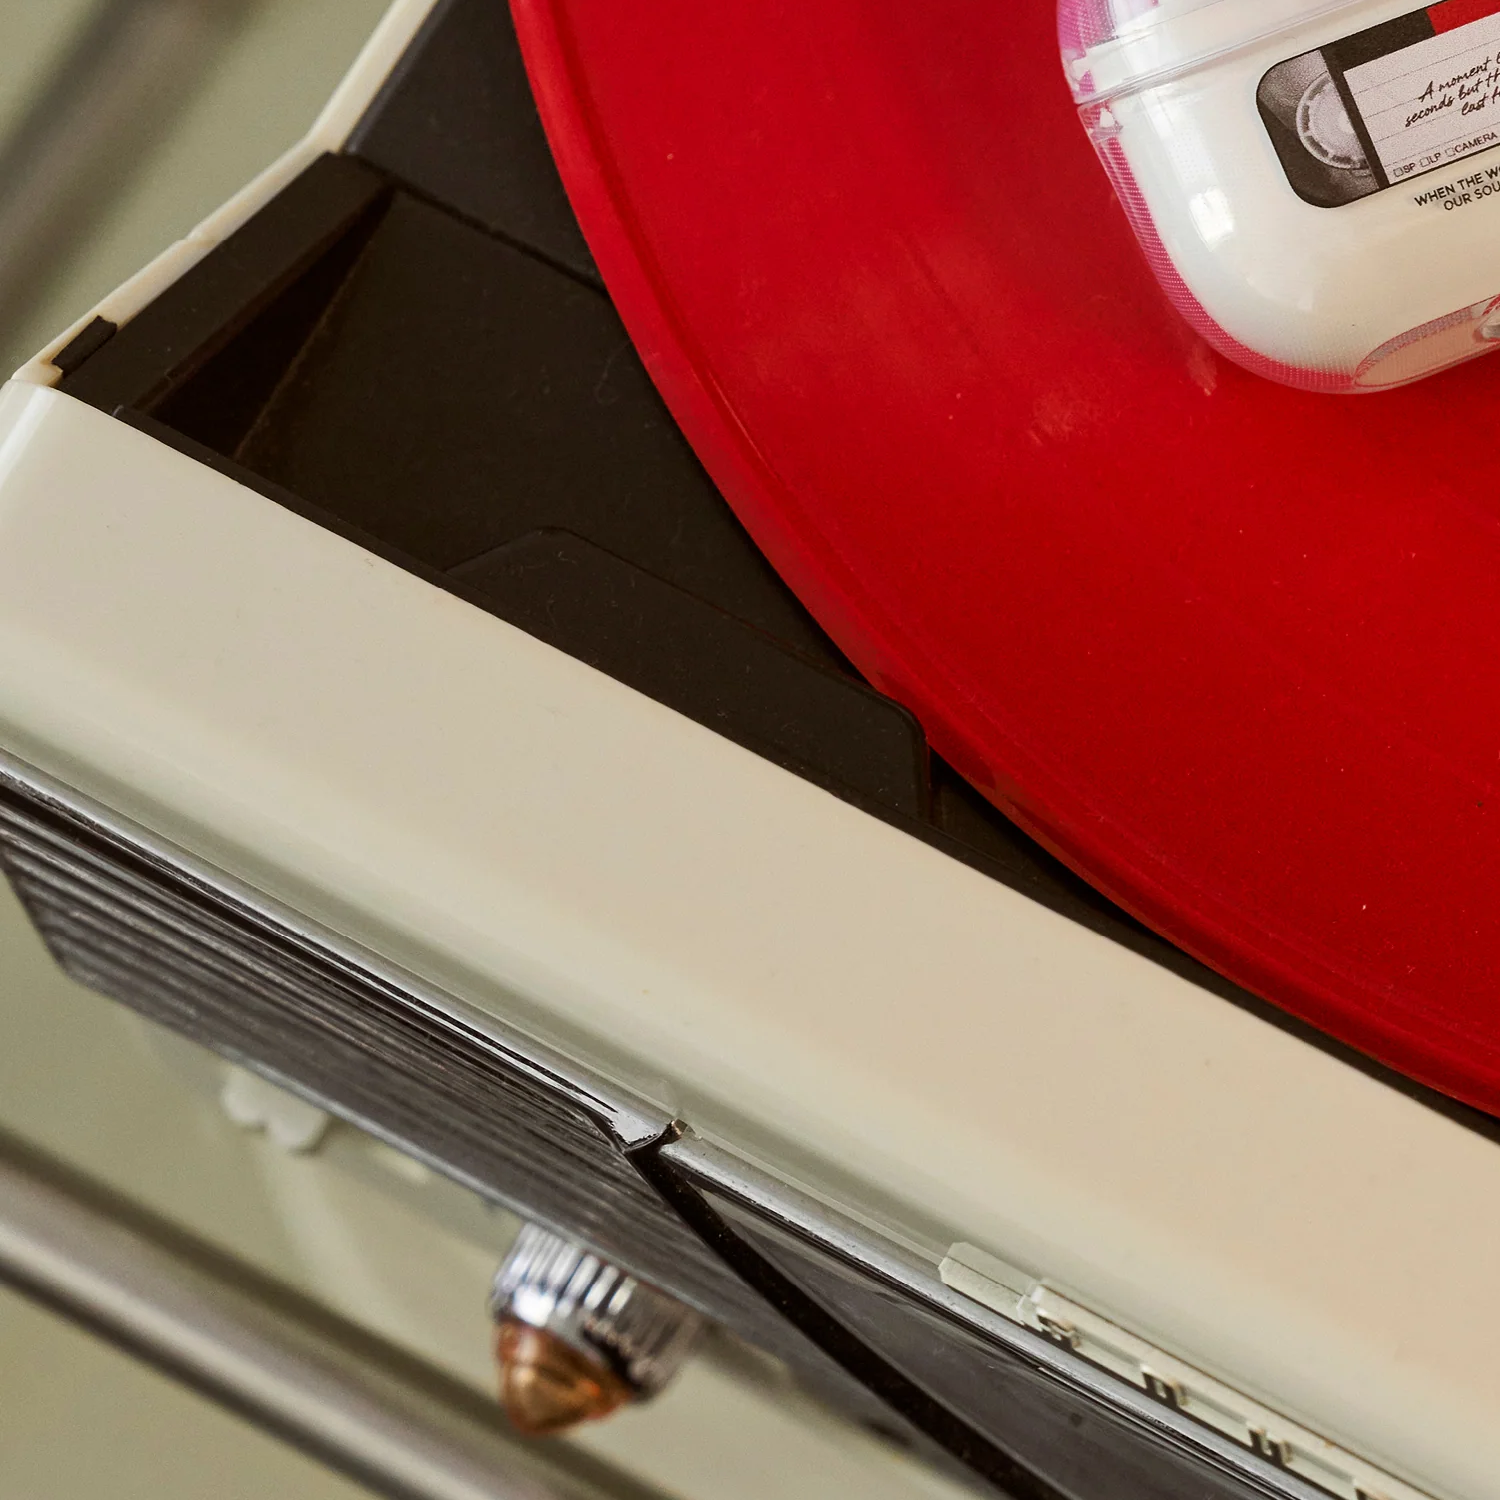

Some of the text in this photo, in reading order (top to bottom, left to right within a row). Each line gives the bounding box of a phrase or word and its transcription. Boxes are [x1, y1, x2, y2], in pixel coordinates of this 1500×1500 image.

[1418, 81, 1435, 102] A
[1439, 56, 1492, 92] moment
[1405, 94, 1454, 128] seconds
[1458, 79, 1484, 101] but
[1461, 93, 1490, 116] last
[1403, 132, 1498, 174] SP LP CAMERA
[1414, 184, 1456, 207] WHEN
[1457, 172, 1484, 192] THE
[1443, 193, 1473, 211] OUR
